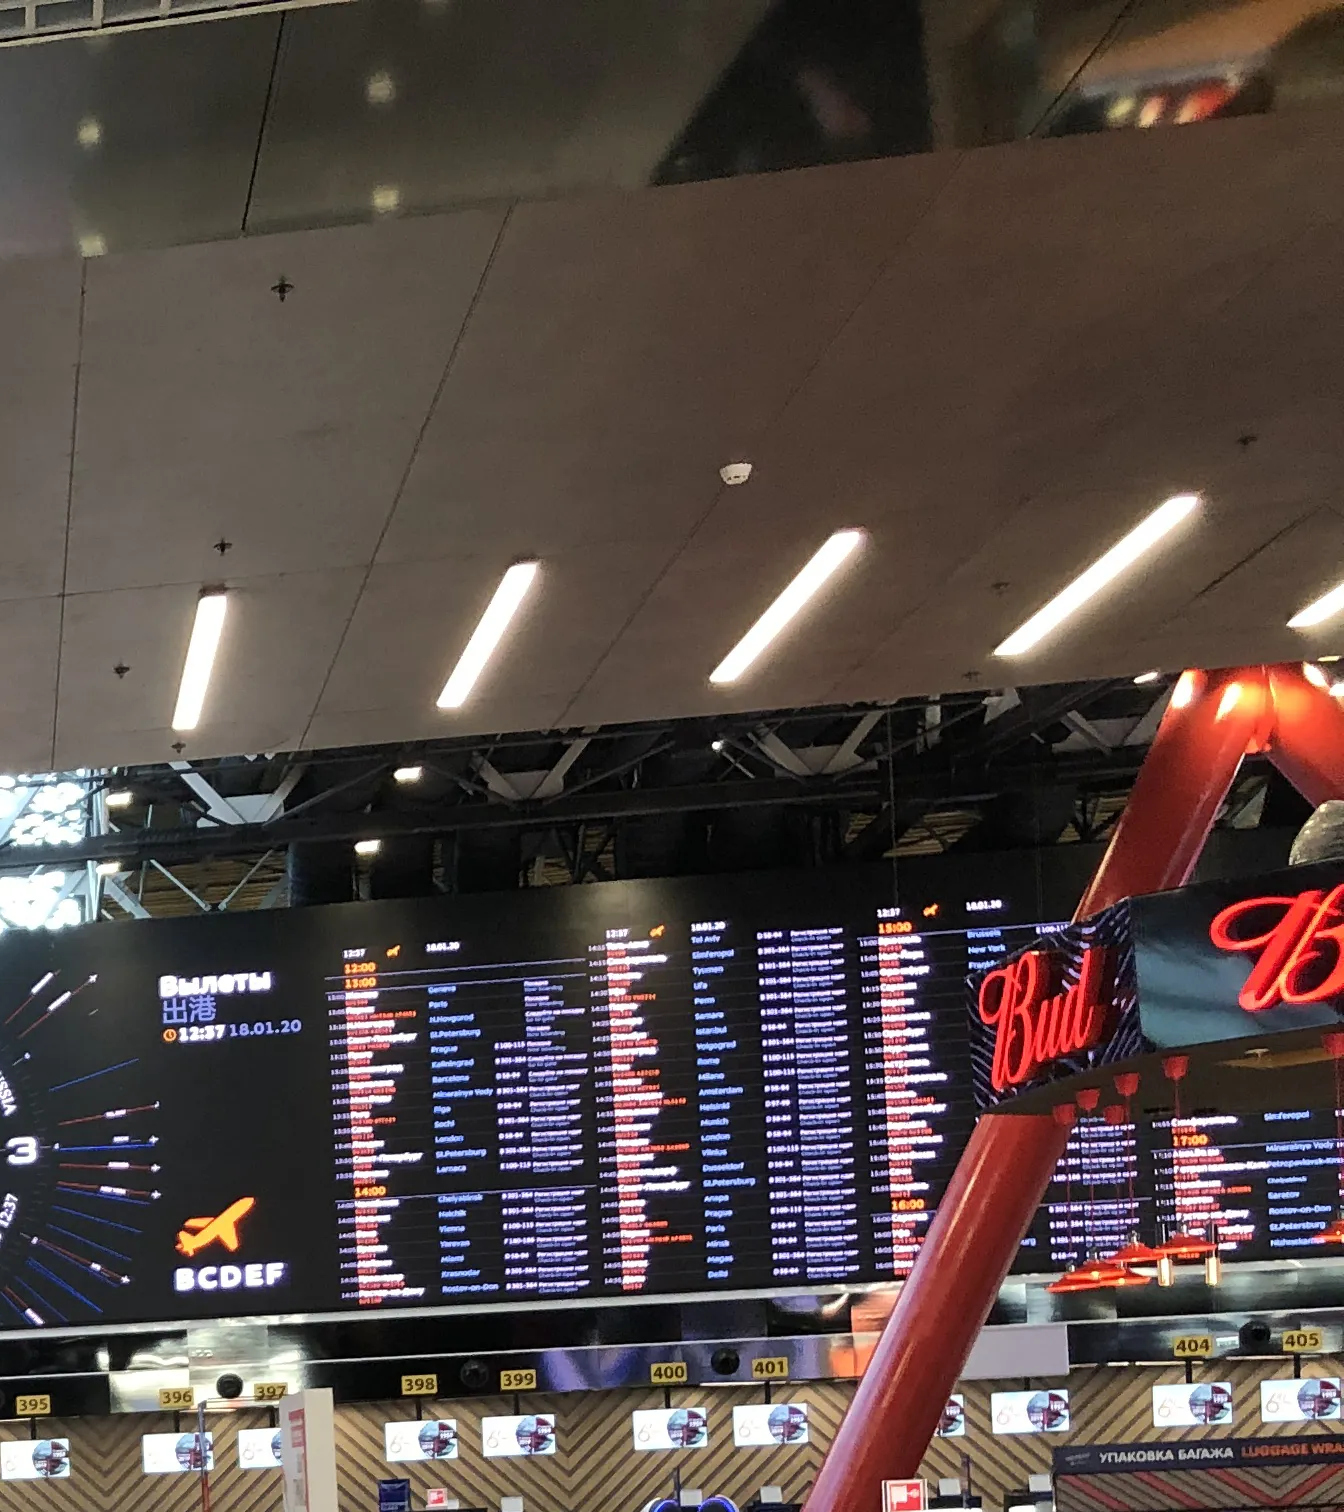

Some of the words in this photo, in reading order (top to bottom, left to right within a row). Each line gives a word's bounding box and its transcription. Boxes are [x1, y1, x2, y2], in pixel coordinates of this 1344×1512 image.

[159, 971, 271, 998] Вылеты
[978, 949, 1096, 1093] Bud
[178, 1025, 226, 1042] 12:37
[230, 1019, 301, 1036] 18.01.20
[7, 1136, 37, 1164] 3
[174, 1262, 284, 1291] BCDEF
[1176, 1339, 1210, 1352] 404
[1285, 1334, 1319, 1347] 405
[653, 1364, 685, 1381] 400
[754, 1361, 785, 1374] 401
[404, 1377, 435, 1392] 398
[503, 1373, 534, 1387] 399
[163, 1391, 192, 1404] 396
[256, 1385, 286, 1399] 397
[19, 1398, 48, 1411] 395
[1099, 1448, 1174, 1463] УПАКОВКА
[1178, 1447, 1234, 1460] БАГАЖА
[1241, 1444, 1309, 1457] LUGGAGE
[1312, 1442, 1344, 1454] WRA
